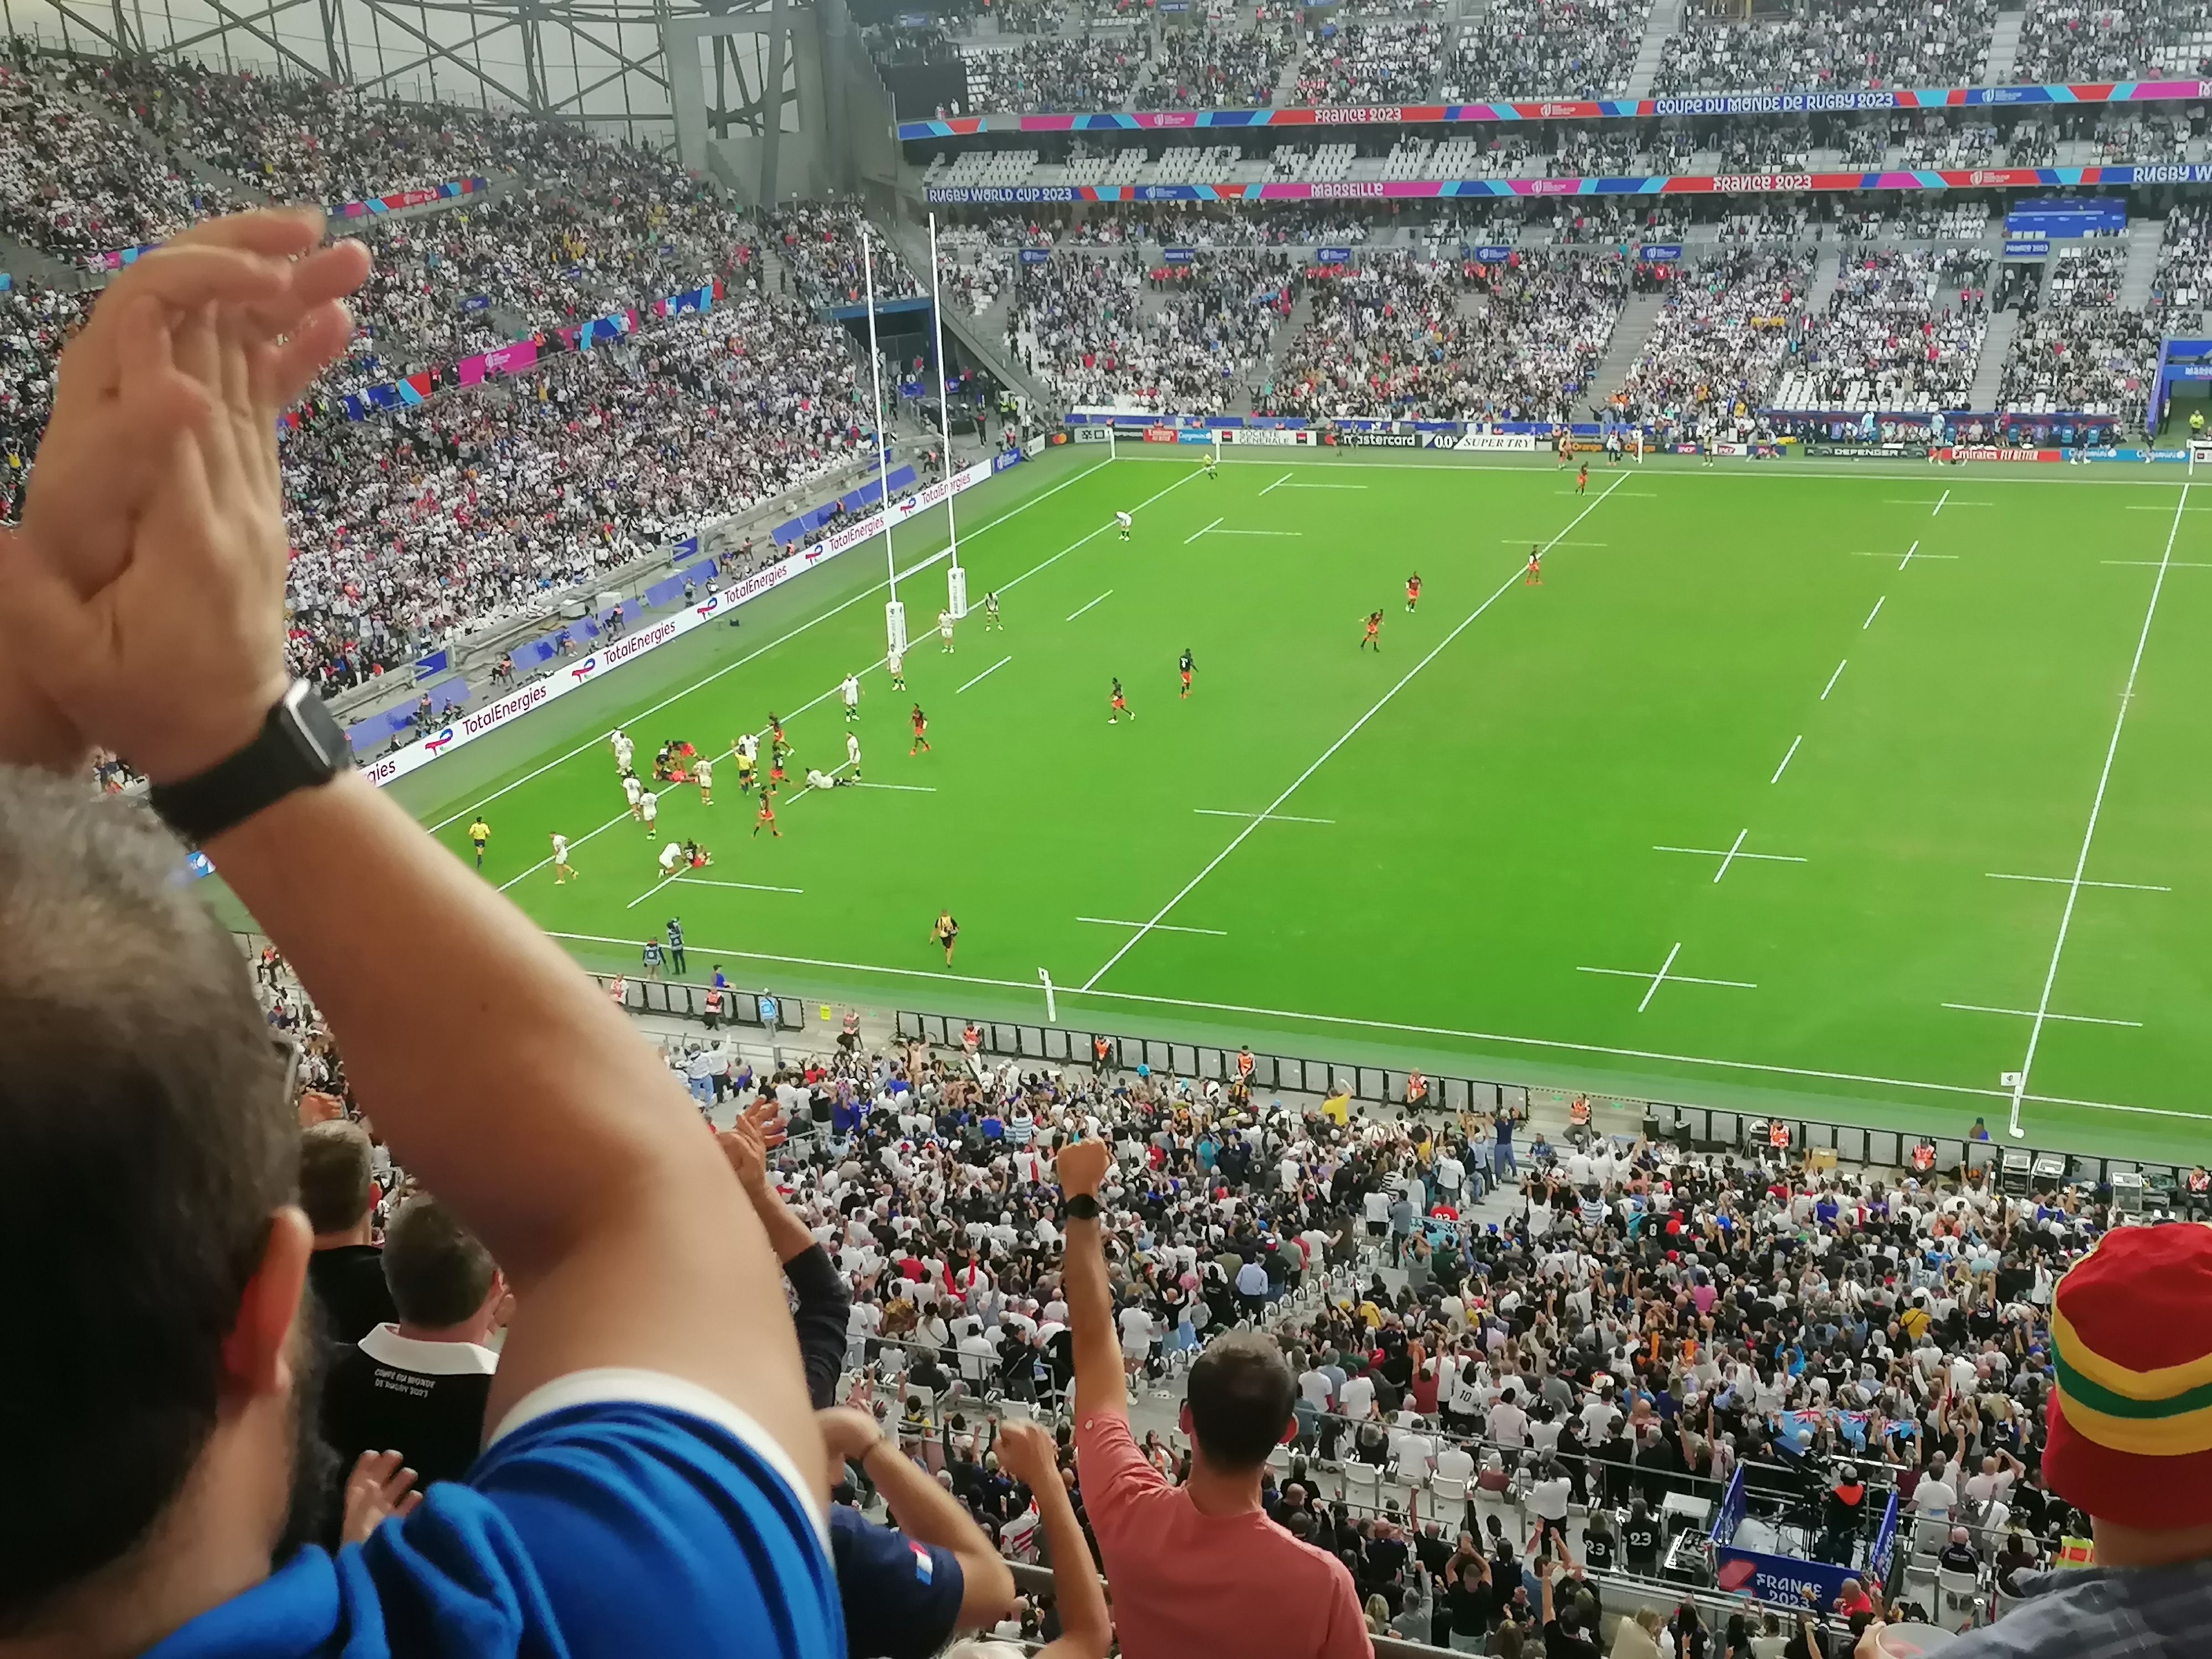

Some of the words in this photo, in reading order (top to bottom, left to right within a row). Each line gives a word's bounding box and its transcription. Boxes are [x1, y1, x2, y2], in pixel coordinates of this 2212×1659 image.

[1656, 100, 1703, 113] COUPE
[1705, 98, 1725, 112] DU
[1728, 96, 1781, 112] MONDE
[1783, 96, 1803, 110] DE
[1806, 93, 1855, 110] RUGBY
[1857, 92, 1893, 108] 2023
[1314, 108, 1366, 123] FRANCE
[1369, 108, 1402, 122] 2023
[2133, 165, 2190, 182] RUGBY
[1311, 182, 1384, 197] MARSEILLE
[1713, 175, 1771, 191] FRANCE
[1775, 175, 1812, 190] 2023
[929, 189, 968, 202] RUGBY
[971, 188, 1014, 202] WORLD
[1016, 188, 1040, 201] CUP
[1043, 187, 1072, 201] 2023
[1463, 438, 1504, 447] SUPER
[1507, 439, 1532, 447] TRY
[1834, 448, 1898, 457] DEFENDER
[829, 517, 884, 551] TotalEnergies
[724, 565, 787, 604] TotalEnergies
[603, 621, 675, 665] TotalEnergies
[462, 686, 546, 735] TotalEnergies
[1459, 1390, 1472, 1402] 10
[1630, 1532, 1652, 1546] 23
[1585, 1540, 1605, 1556] 23
[1769, 1589, 1810, 1609] 2023
